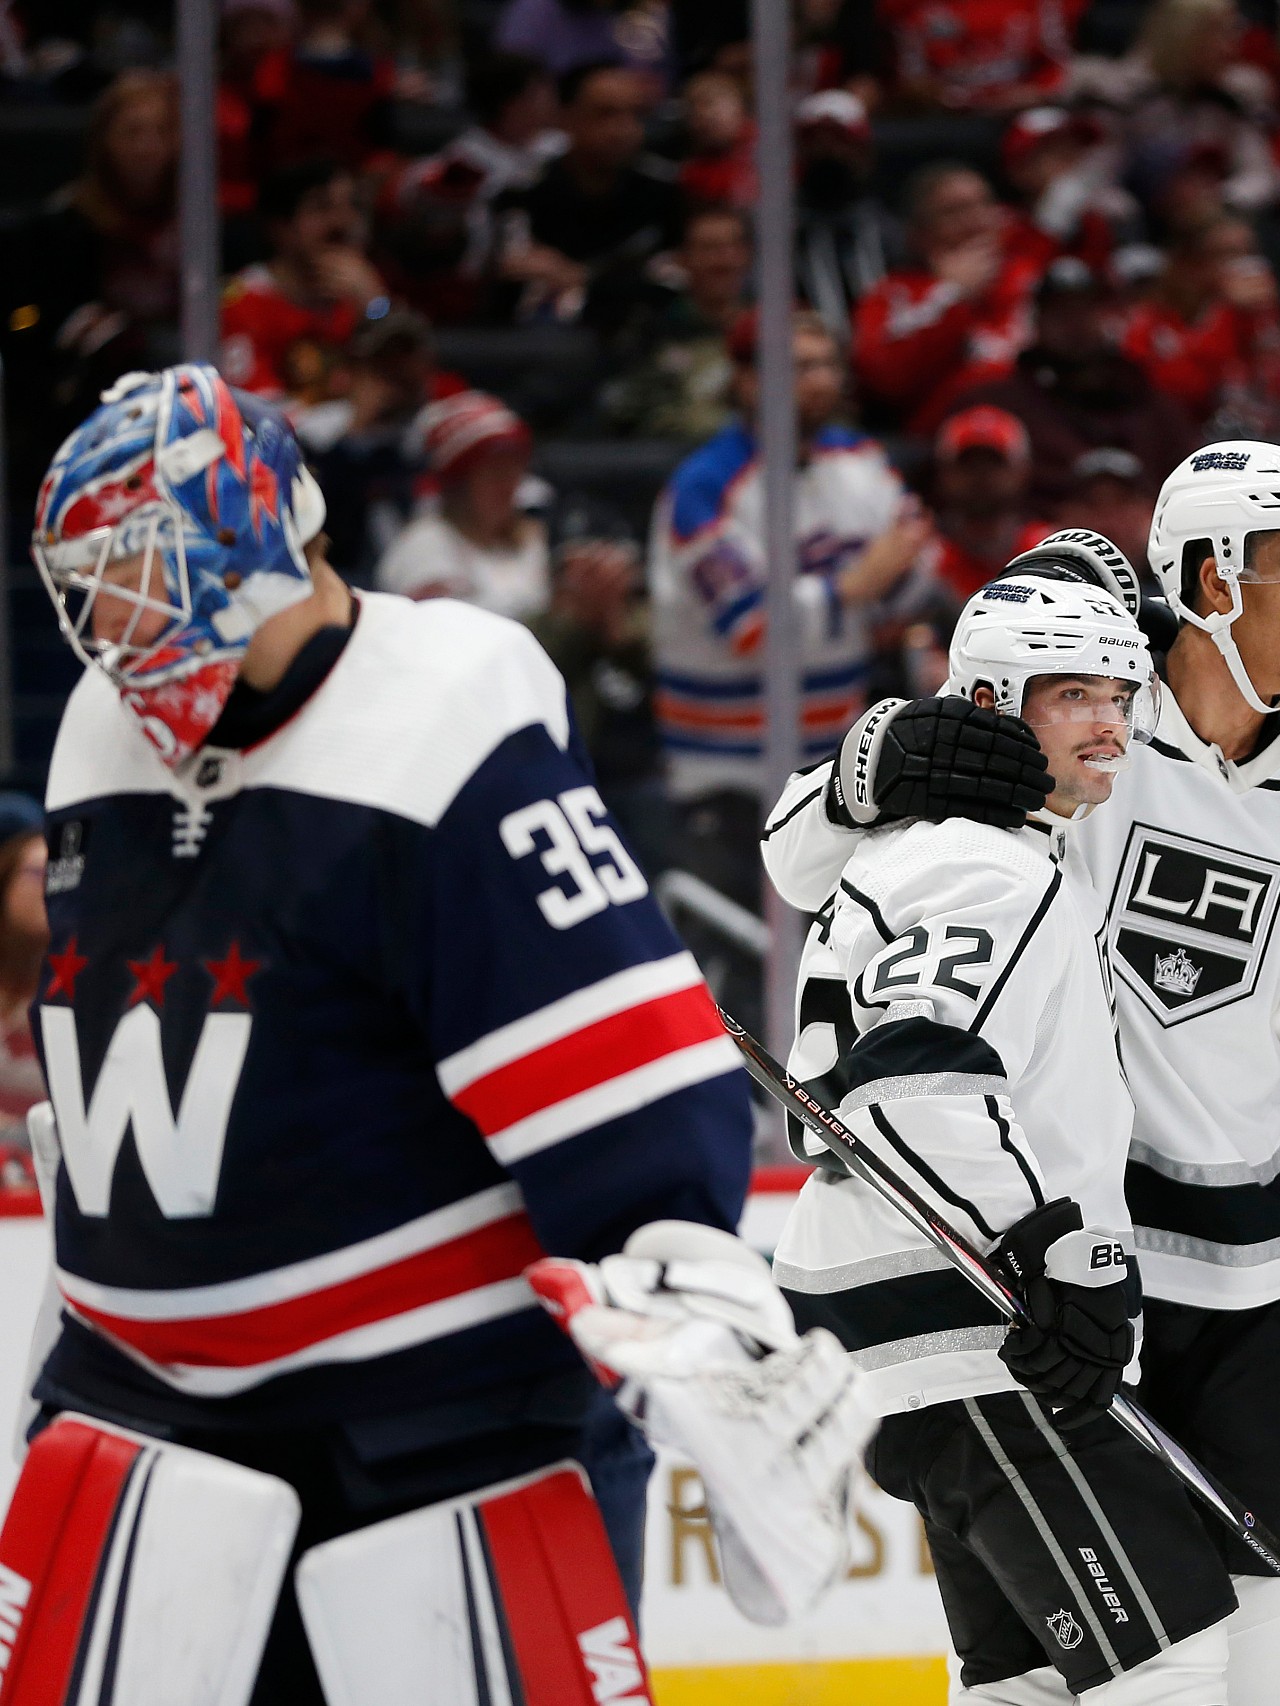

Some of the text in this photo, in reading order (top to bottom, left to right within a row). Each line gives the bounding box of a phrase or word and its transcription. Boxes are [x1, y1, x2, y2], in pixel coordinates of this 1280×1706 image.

[1190, 452, 1250, 465] AMERICAN
[1193, 461, 1247, 472] EXPRESS
[982, 591, 1030, 603] EXPRESS
[983, 583, 1037, 596] AMERICAN
[1099, 636, 1139, 649] BAUER
[499, 785, 649, 931] 35
[1132, 851, 1266, 933] LA
[871, 924, 996, 1003] 22
[40, 1001, 252, 1219] W
[794, 1088, 857, 1148] BAUER
[1007, 1250, 1023, 1278] FIALA
[1078, 1547, 1130, 1625] BAUER
